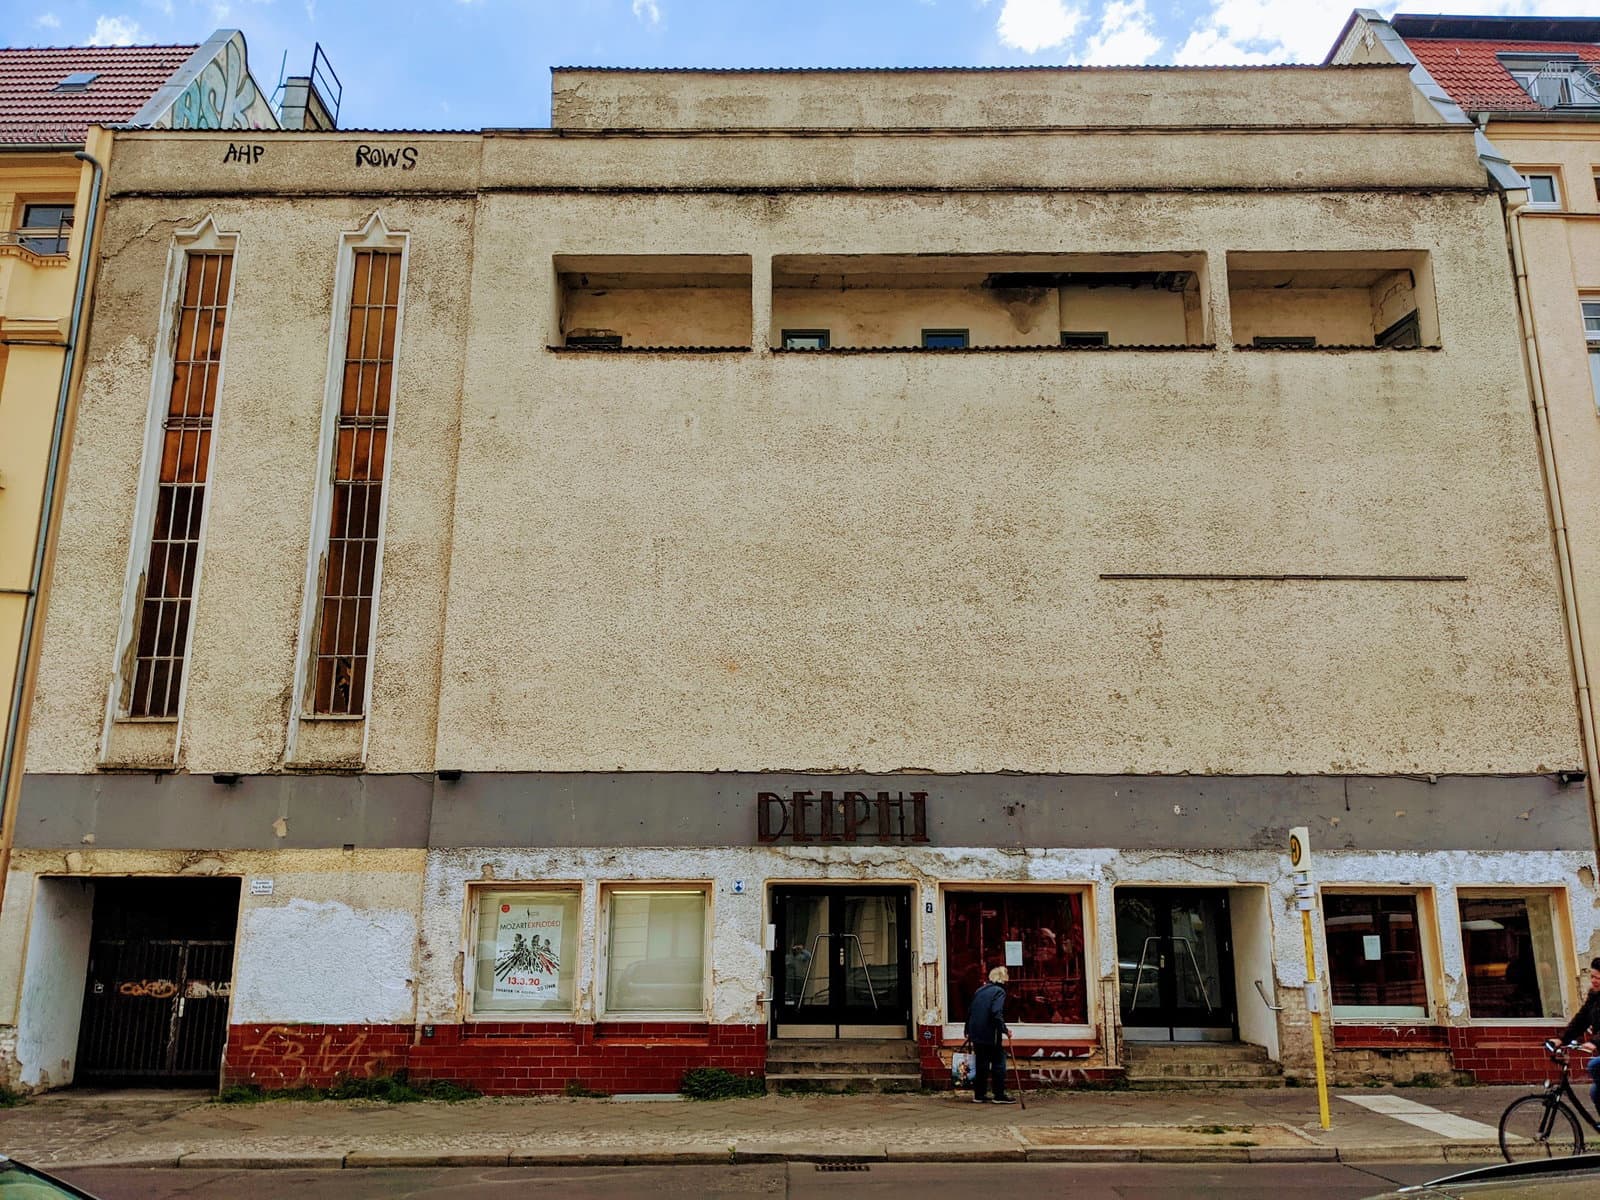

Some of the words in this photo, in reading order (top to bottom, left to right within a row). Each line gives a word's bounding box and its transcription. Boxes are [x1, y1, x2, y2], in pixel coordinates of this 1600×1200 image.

[223, 143, 265, 165] AHP
[356, 144, 418, 170] ROWS
[757, 791, 931, 842] DELPHI
